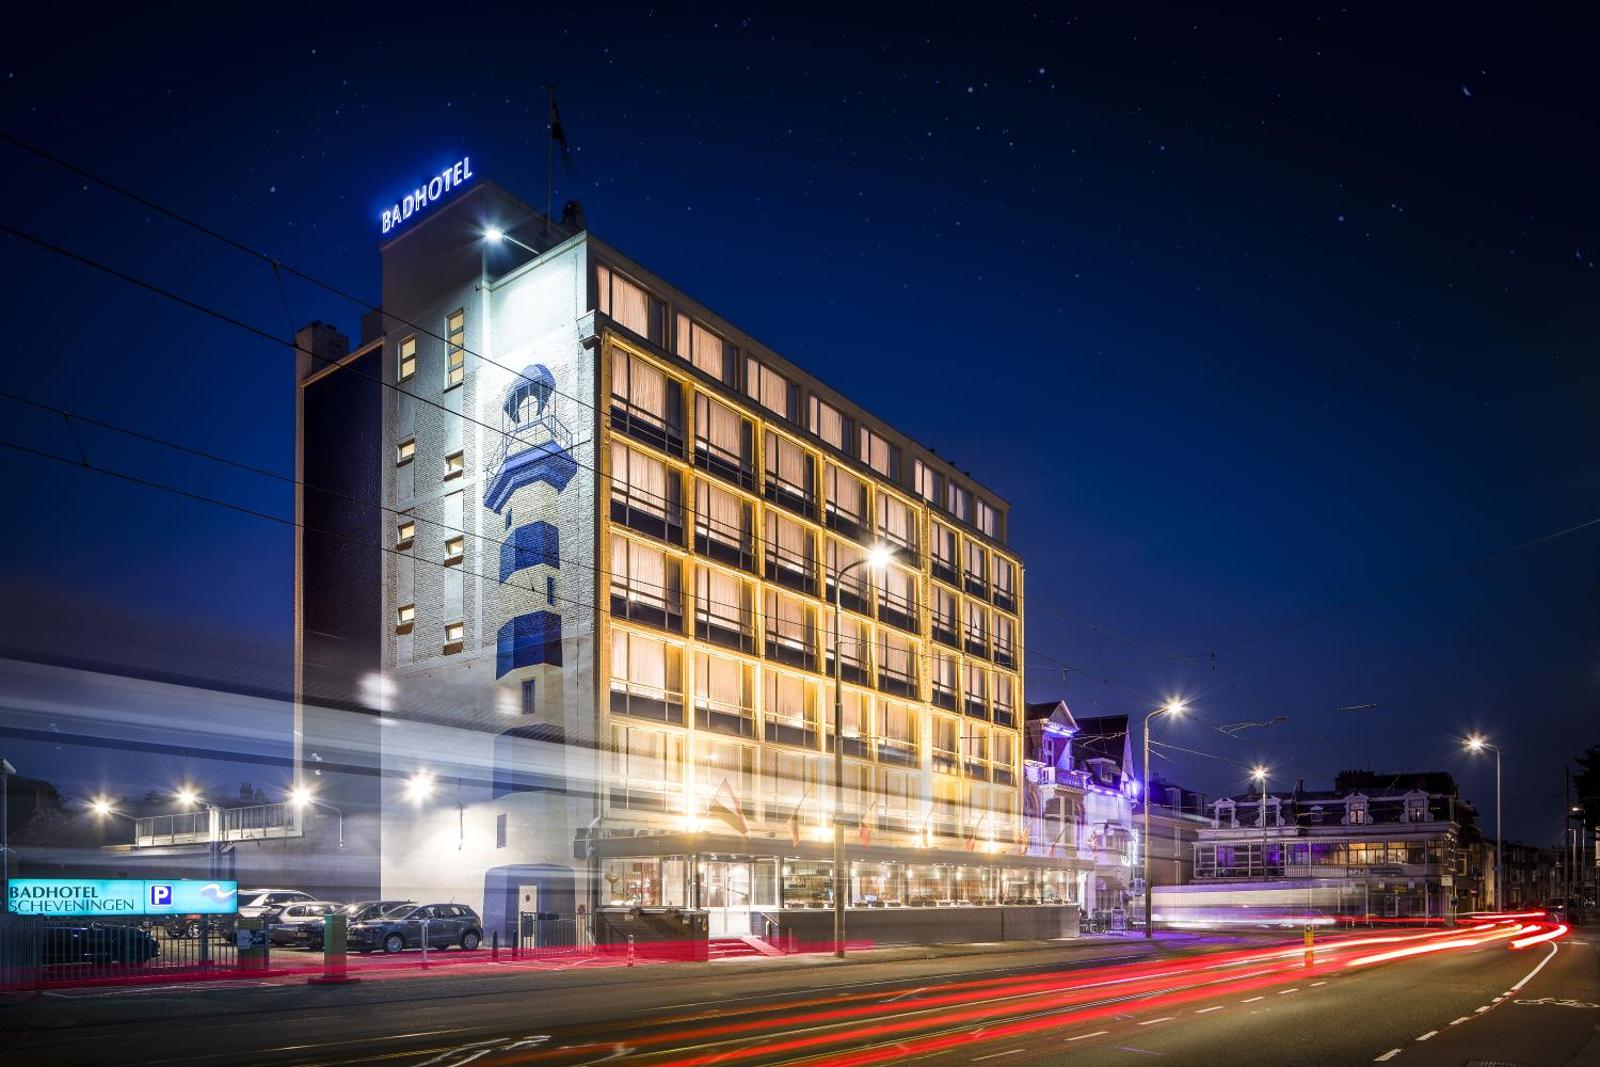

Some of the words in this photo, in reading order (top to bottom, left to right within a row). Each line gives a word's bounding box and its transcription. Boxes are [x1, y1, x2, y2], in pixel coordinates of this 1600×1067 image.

[382, 157, 472, 234] BADHOTEL
[9, 886, 98, 898] BADHOTEL
[154, 886, 169, 905] P
[9, 899, 135, 912] SCHEVENINGEN
